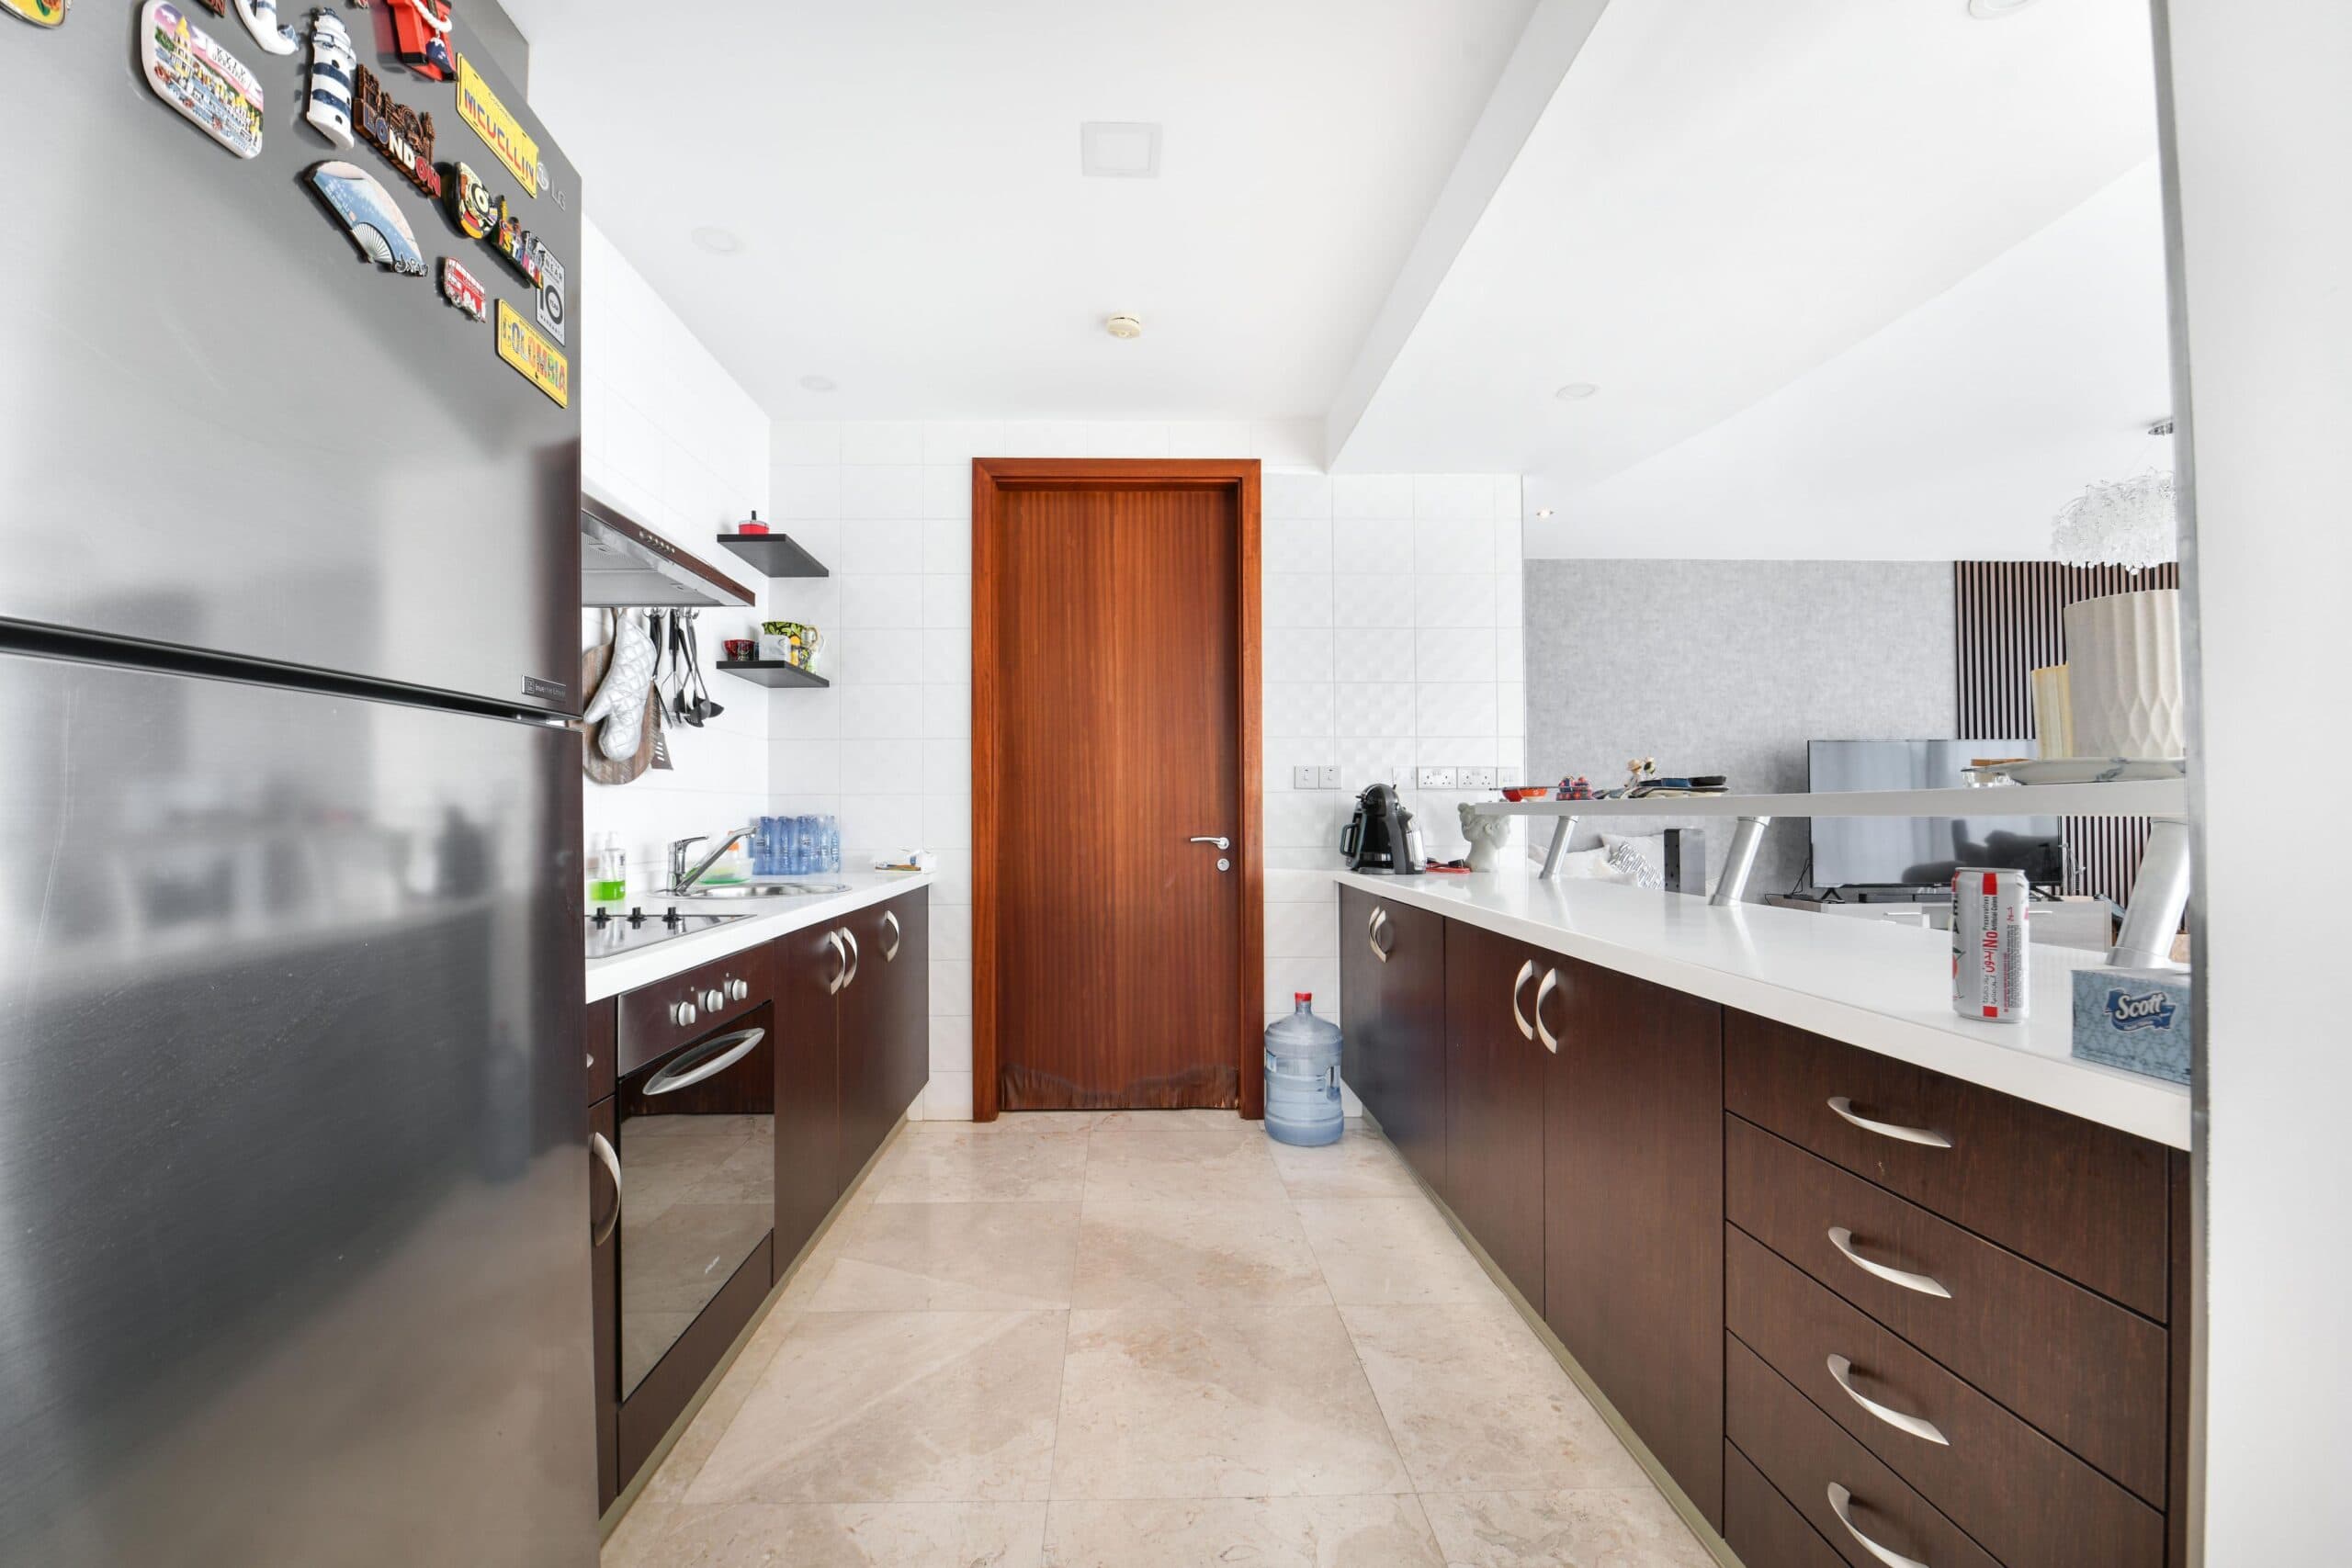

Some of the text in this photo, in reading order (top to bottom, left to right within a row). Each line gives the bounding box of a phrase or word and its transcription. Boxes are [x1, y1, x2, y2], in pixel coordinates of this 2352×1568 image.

[216, 46, 246, 76] KYIV
[363, 102, 441, 198] LONDON
[551, 179, 567, 212] LG
[502, 316, 568, 397] COLOMBIA
[1982, 896, 1990, 931] Preservatives
[1982, 931, 1998, 949] No
[2115, 993, 2165, 1020] Scott
